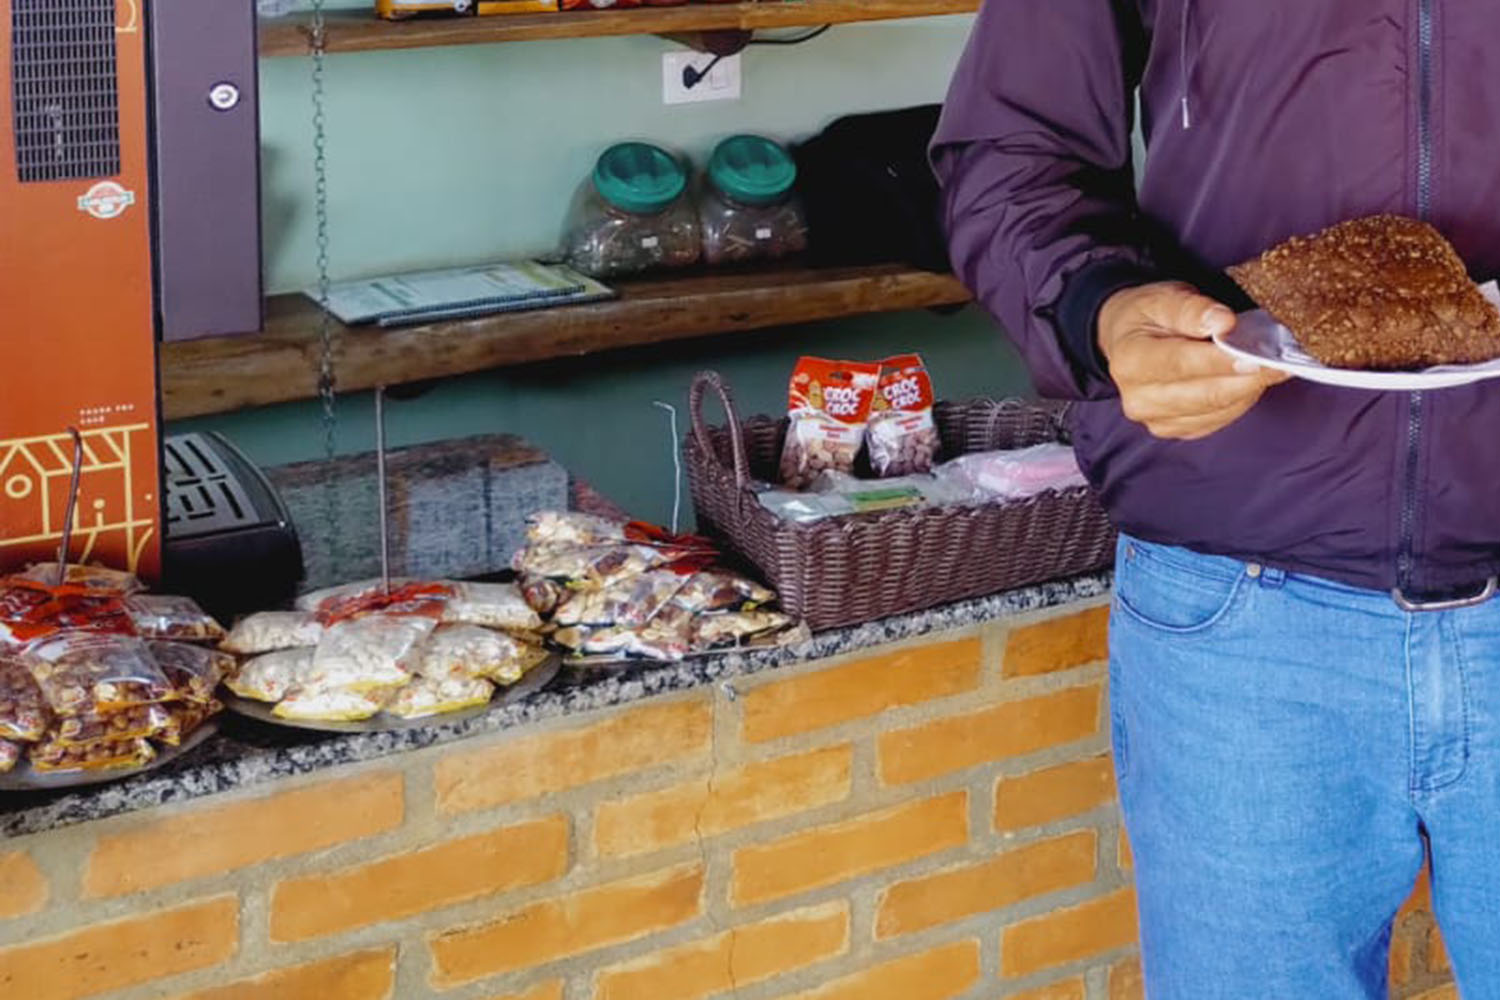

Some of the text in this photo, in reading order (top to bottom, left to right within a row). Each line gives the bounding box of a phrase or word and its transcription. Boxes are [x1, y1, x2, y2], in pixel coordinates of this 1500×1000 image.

[824, 386, 861, 402] CROC
[883, 376, 920, 400] CROC
[825, 401, 860, 416] CROC
